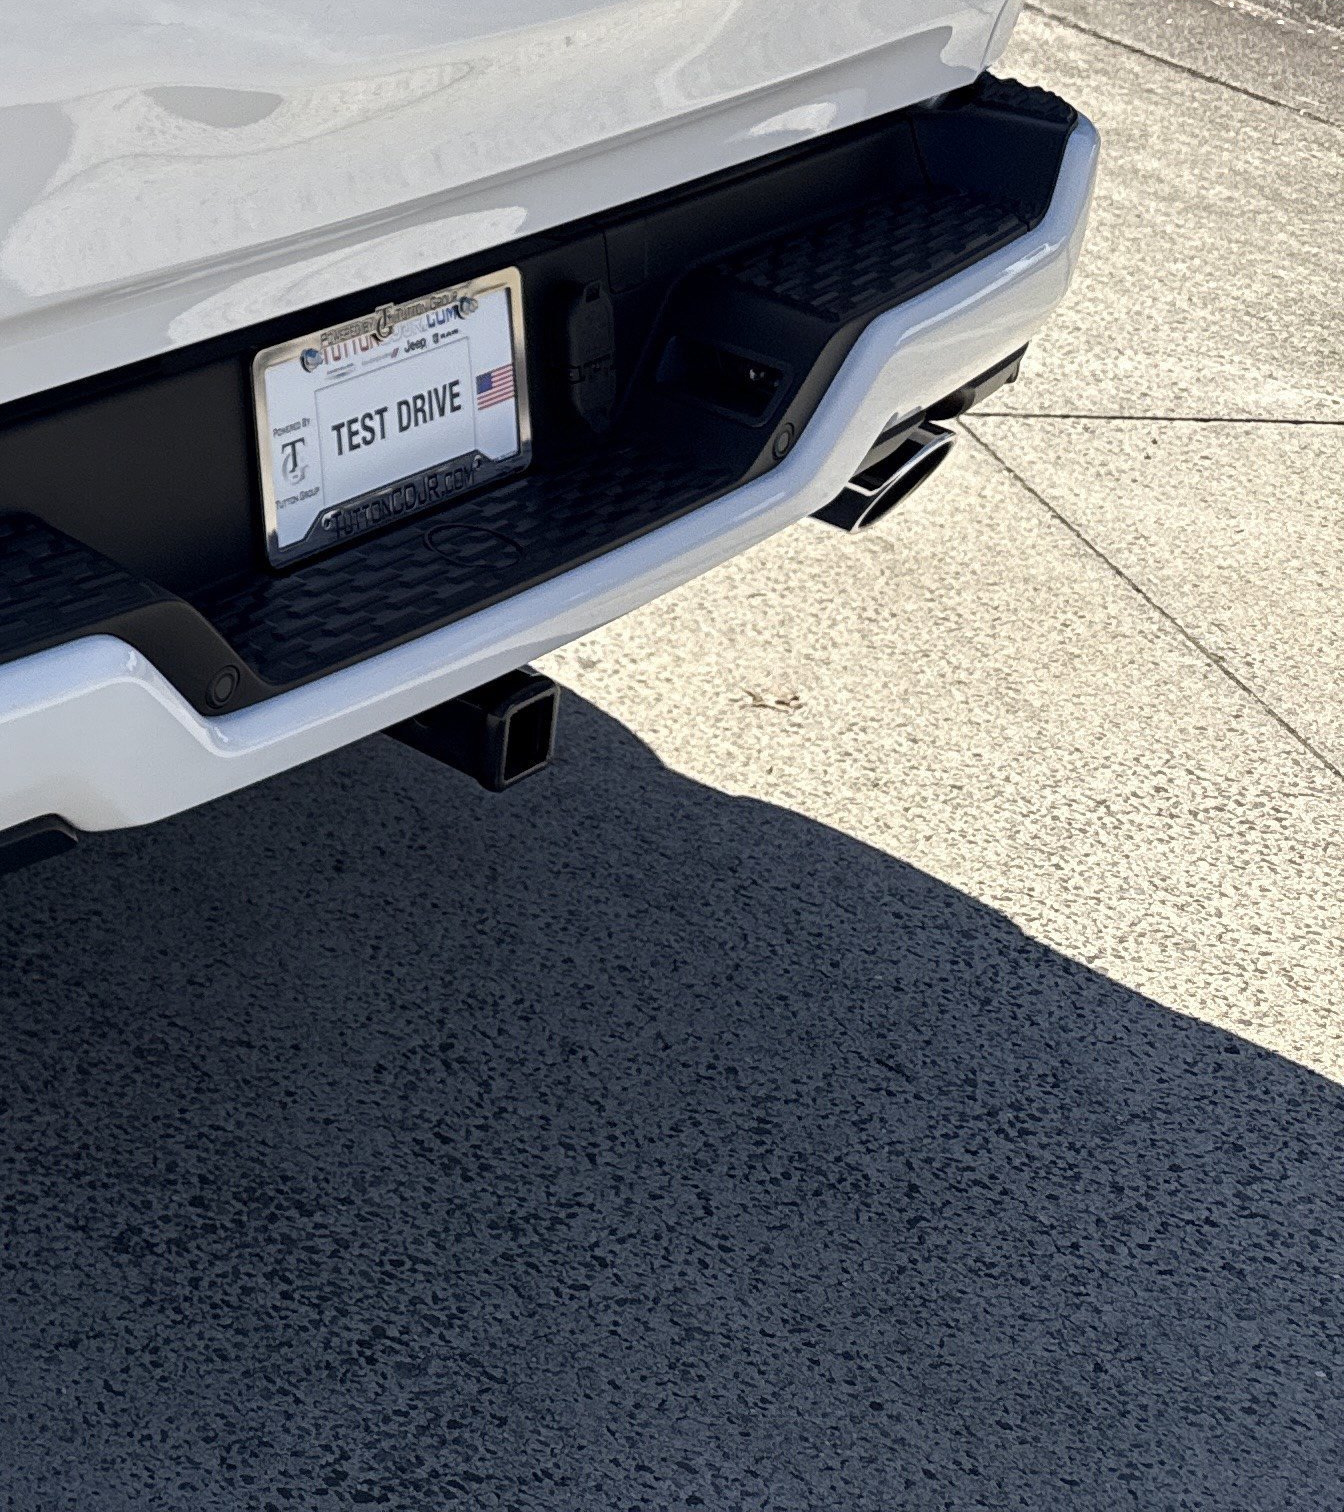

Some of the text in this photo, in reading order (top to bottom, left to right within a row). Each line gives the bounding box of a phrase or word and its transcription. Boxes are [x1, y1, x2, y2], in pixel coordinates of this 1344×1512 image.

[404, 338, 427, 354] Jeep
[331, 379, 462, 456] TEST DRIVE
[331, 463, 477, 538] TUTTONCDJR.COM
